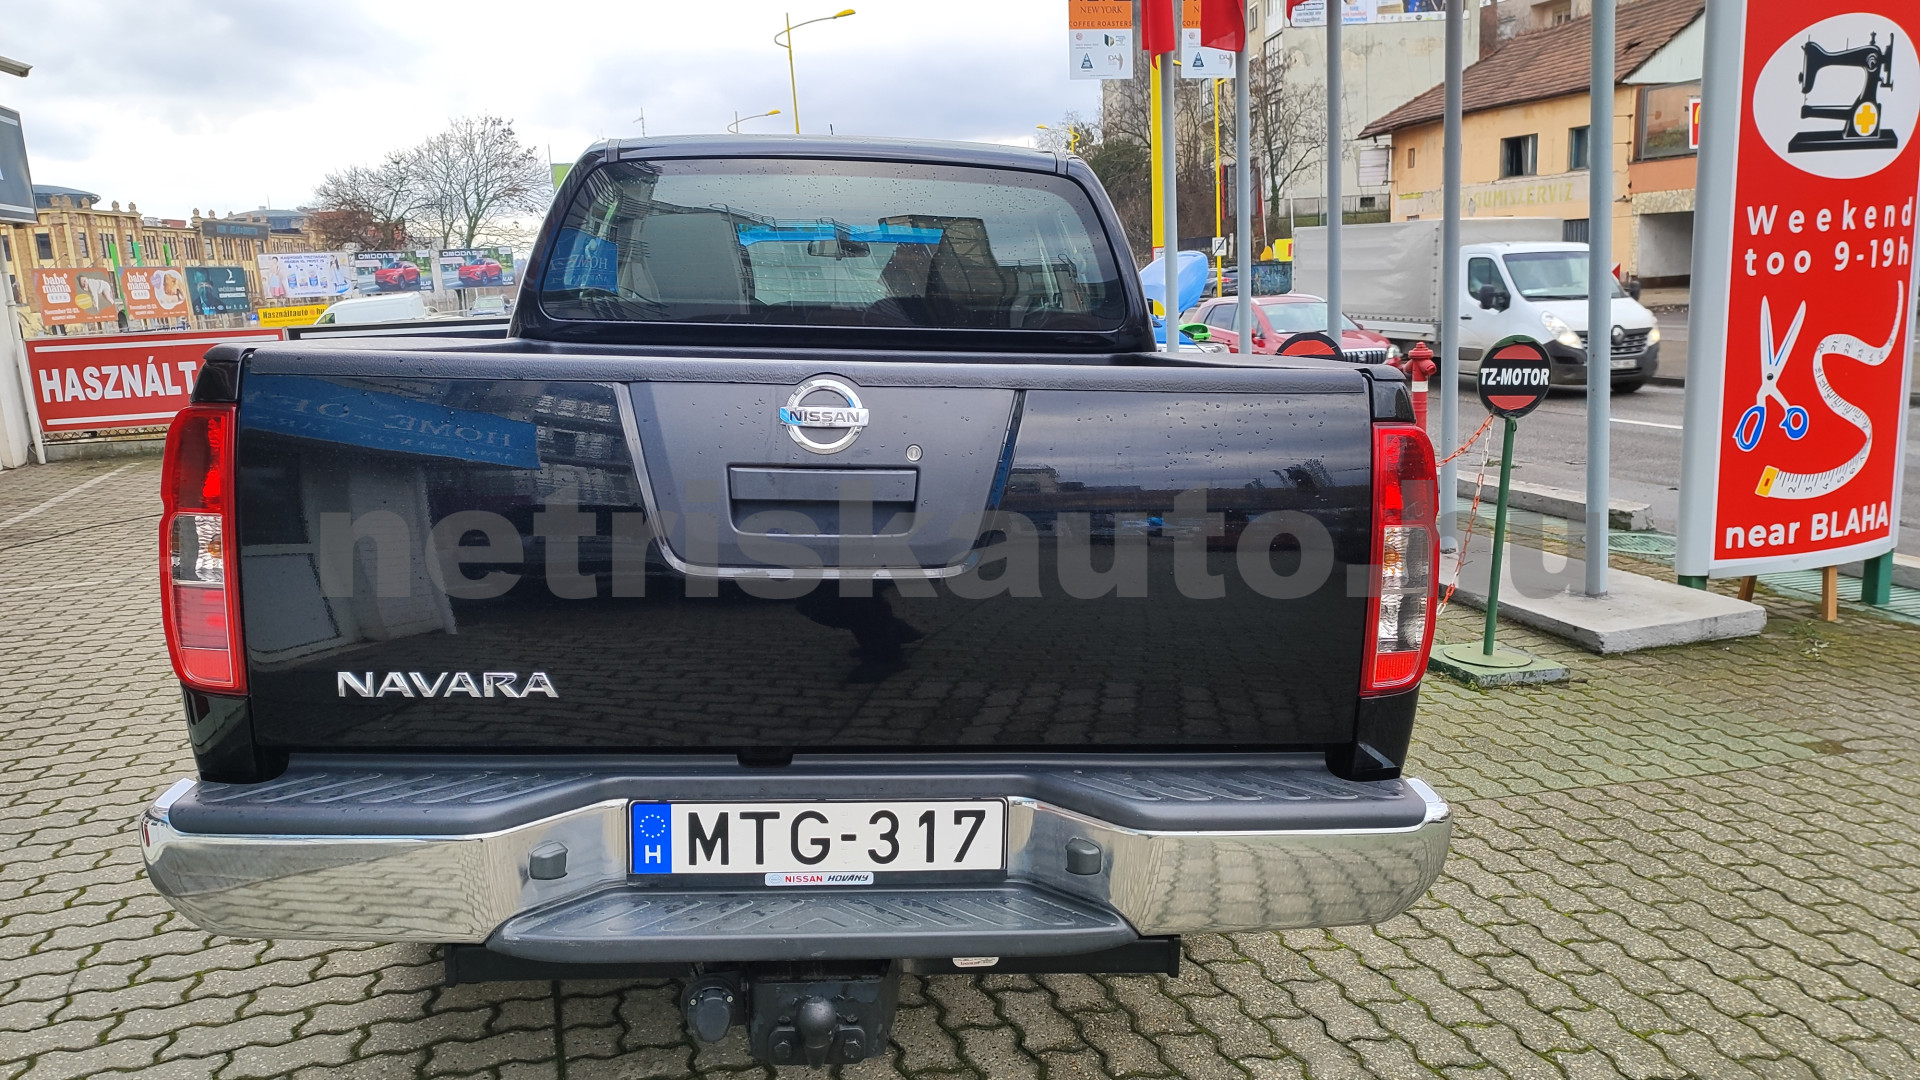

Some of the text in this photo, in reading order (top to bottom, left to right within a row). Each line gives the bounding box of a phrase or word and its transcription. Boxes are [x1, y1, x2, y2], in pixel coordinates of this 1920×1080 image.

[1080, 5, 1122, 14] NEW YORK
[1474, 183, 1574, 208] GUMISZERVIZ
[1746, 196, 1913, 236] Weekend
[1744, 236, 1909, 276] too 9-19h
[42, 273, 66, 285] baba
[127, 272, 147, 283] baba
[127, 282, 150, 291] mama
[42, 284, 71, 294] mama
[38, 356, 196, 403] HASZNÁLT
[1480, 368, 1550, 386] TZ-MOTOR
[789, 410, 860, 423] NISSAN
[1725, 501, 1889, 549] near BLAHA
[337, 671, 560, 698] NAVARA
[644, 809, 986, 866] H MTG-317
